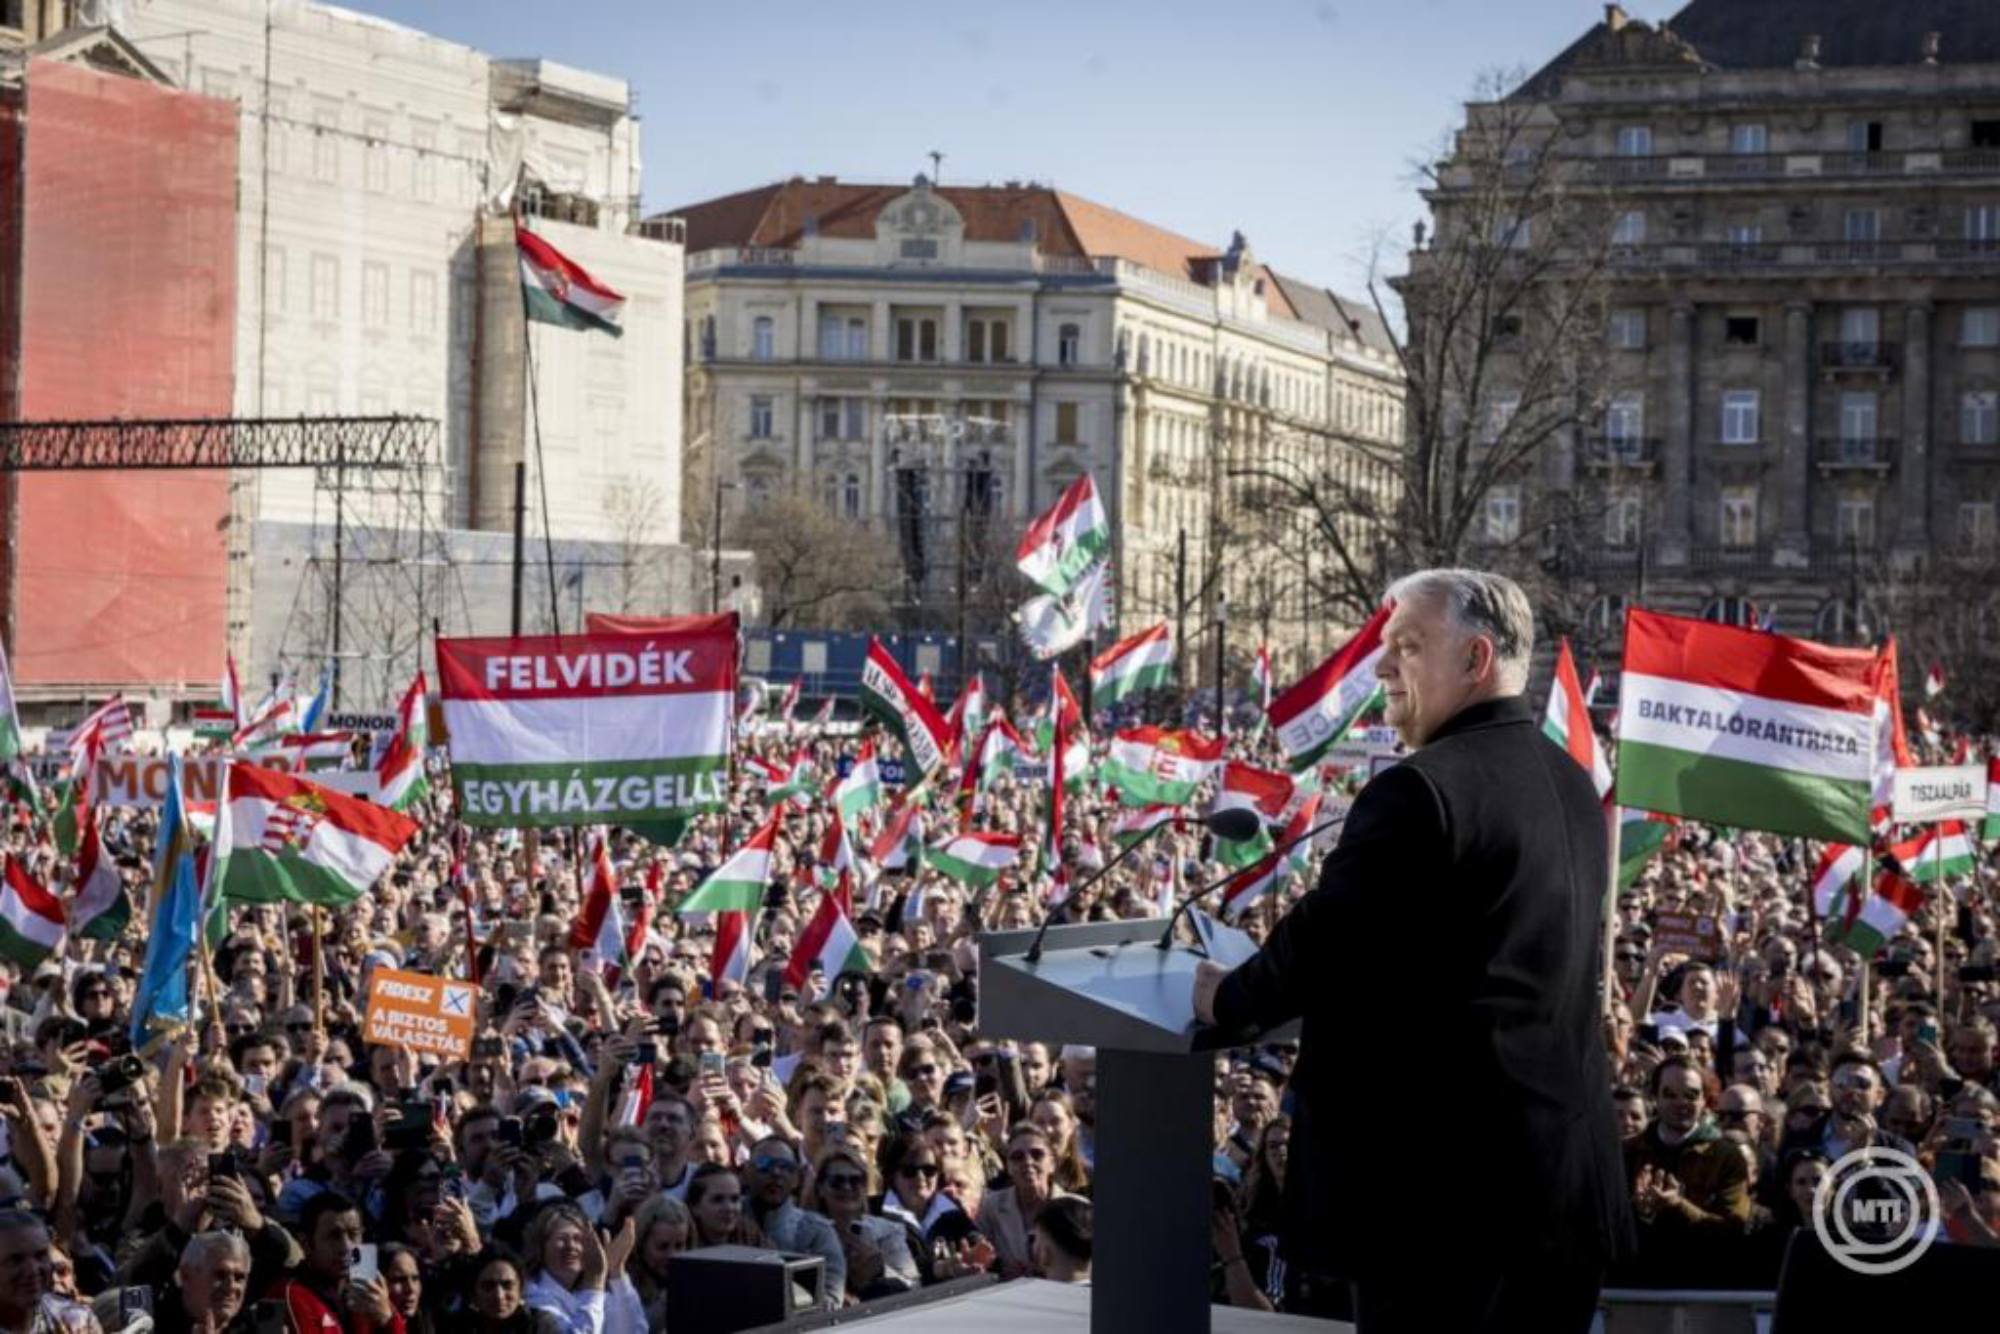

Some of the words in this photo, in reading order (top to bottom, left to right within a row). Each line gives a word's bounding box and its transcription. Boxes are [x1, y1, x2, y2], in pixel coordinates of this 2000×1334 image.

[485, 642, 693, 690] FELVIDÉK
[328, 713, 396, 730] MONOR
[1638, 698, 1859, 756] BAKTALÓRÁNTHÁZA
[1909, 779, 1971, 802] TISZAALPÁR
[376, 979, 435, 1004] FIDESZ
[372, 1007, 386, 1024] A
[387, 1010, 449, 1034] BIZTOS
[370, 1021, 467, 1054] VÁLASZTÁS
